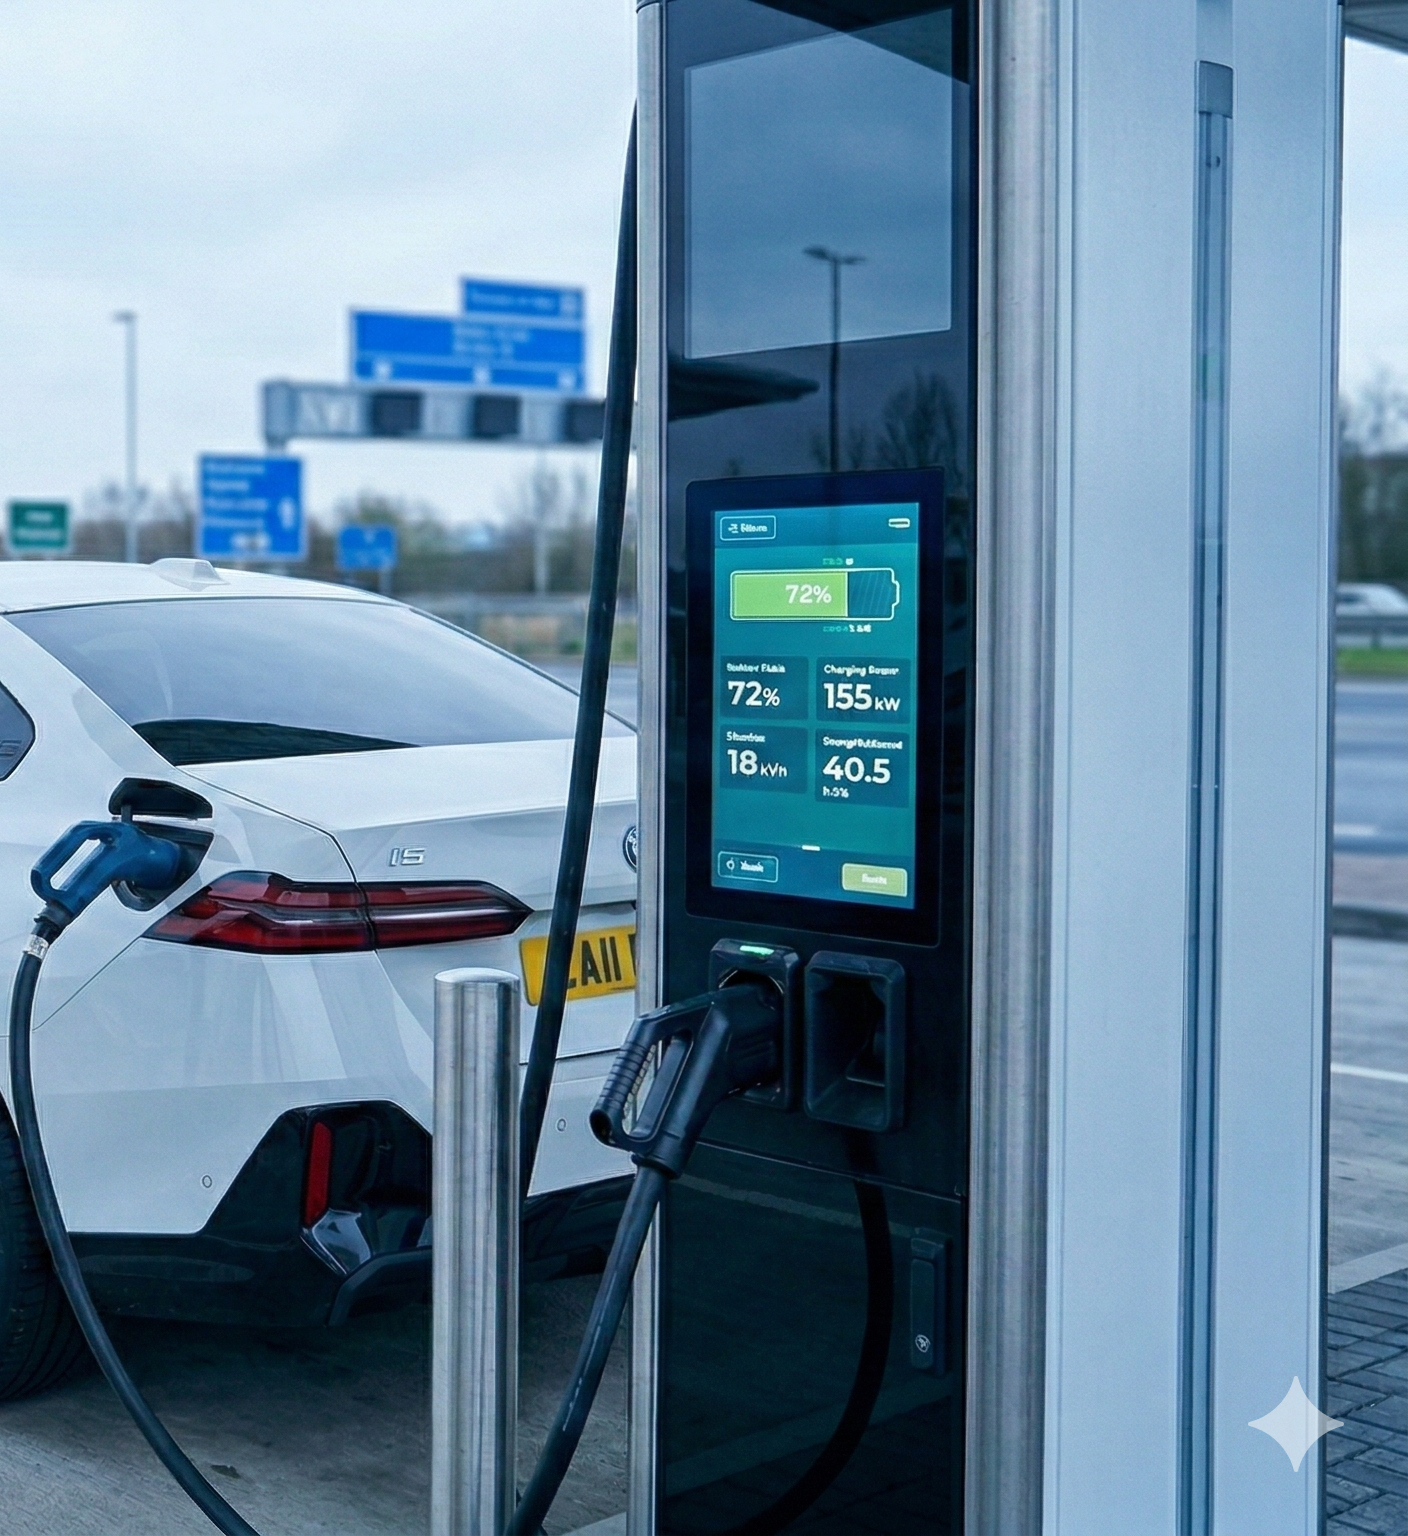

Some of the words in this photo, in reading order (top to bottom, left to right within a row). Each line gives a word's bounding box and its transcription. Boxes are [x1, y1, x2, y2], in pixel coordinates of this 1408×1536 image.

[785, 584, 832, 604] 72%
[727, 680, 780, 707] 72%
[823, 682, 873, 710] 155
[874, 696, 901, 712] kW
[727, 749, 758, 776] 18
[822, 755, 891, 784] 40.5
